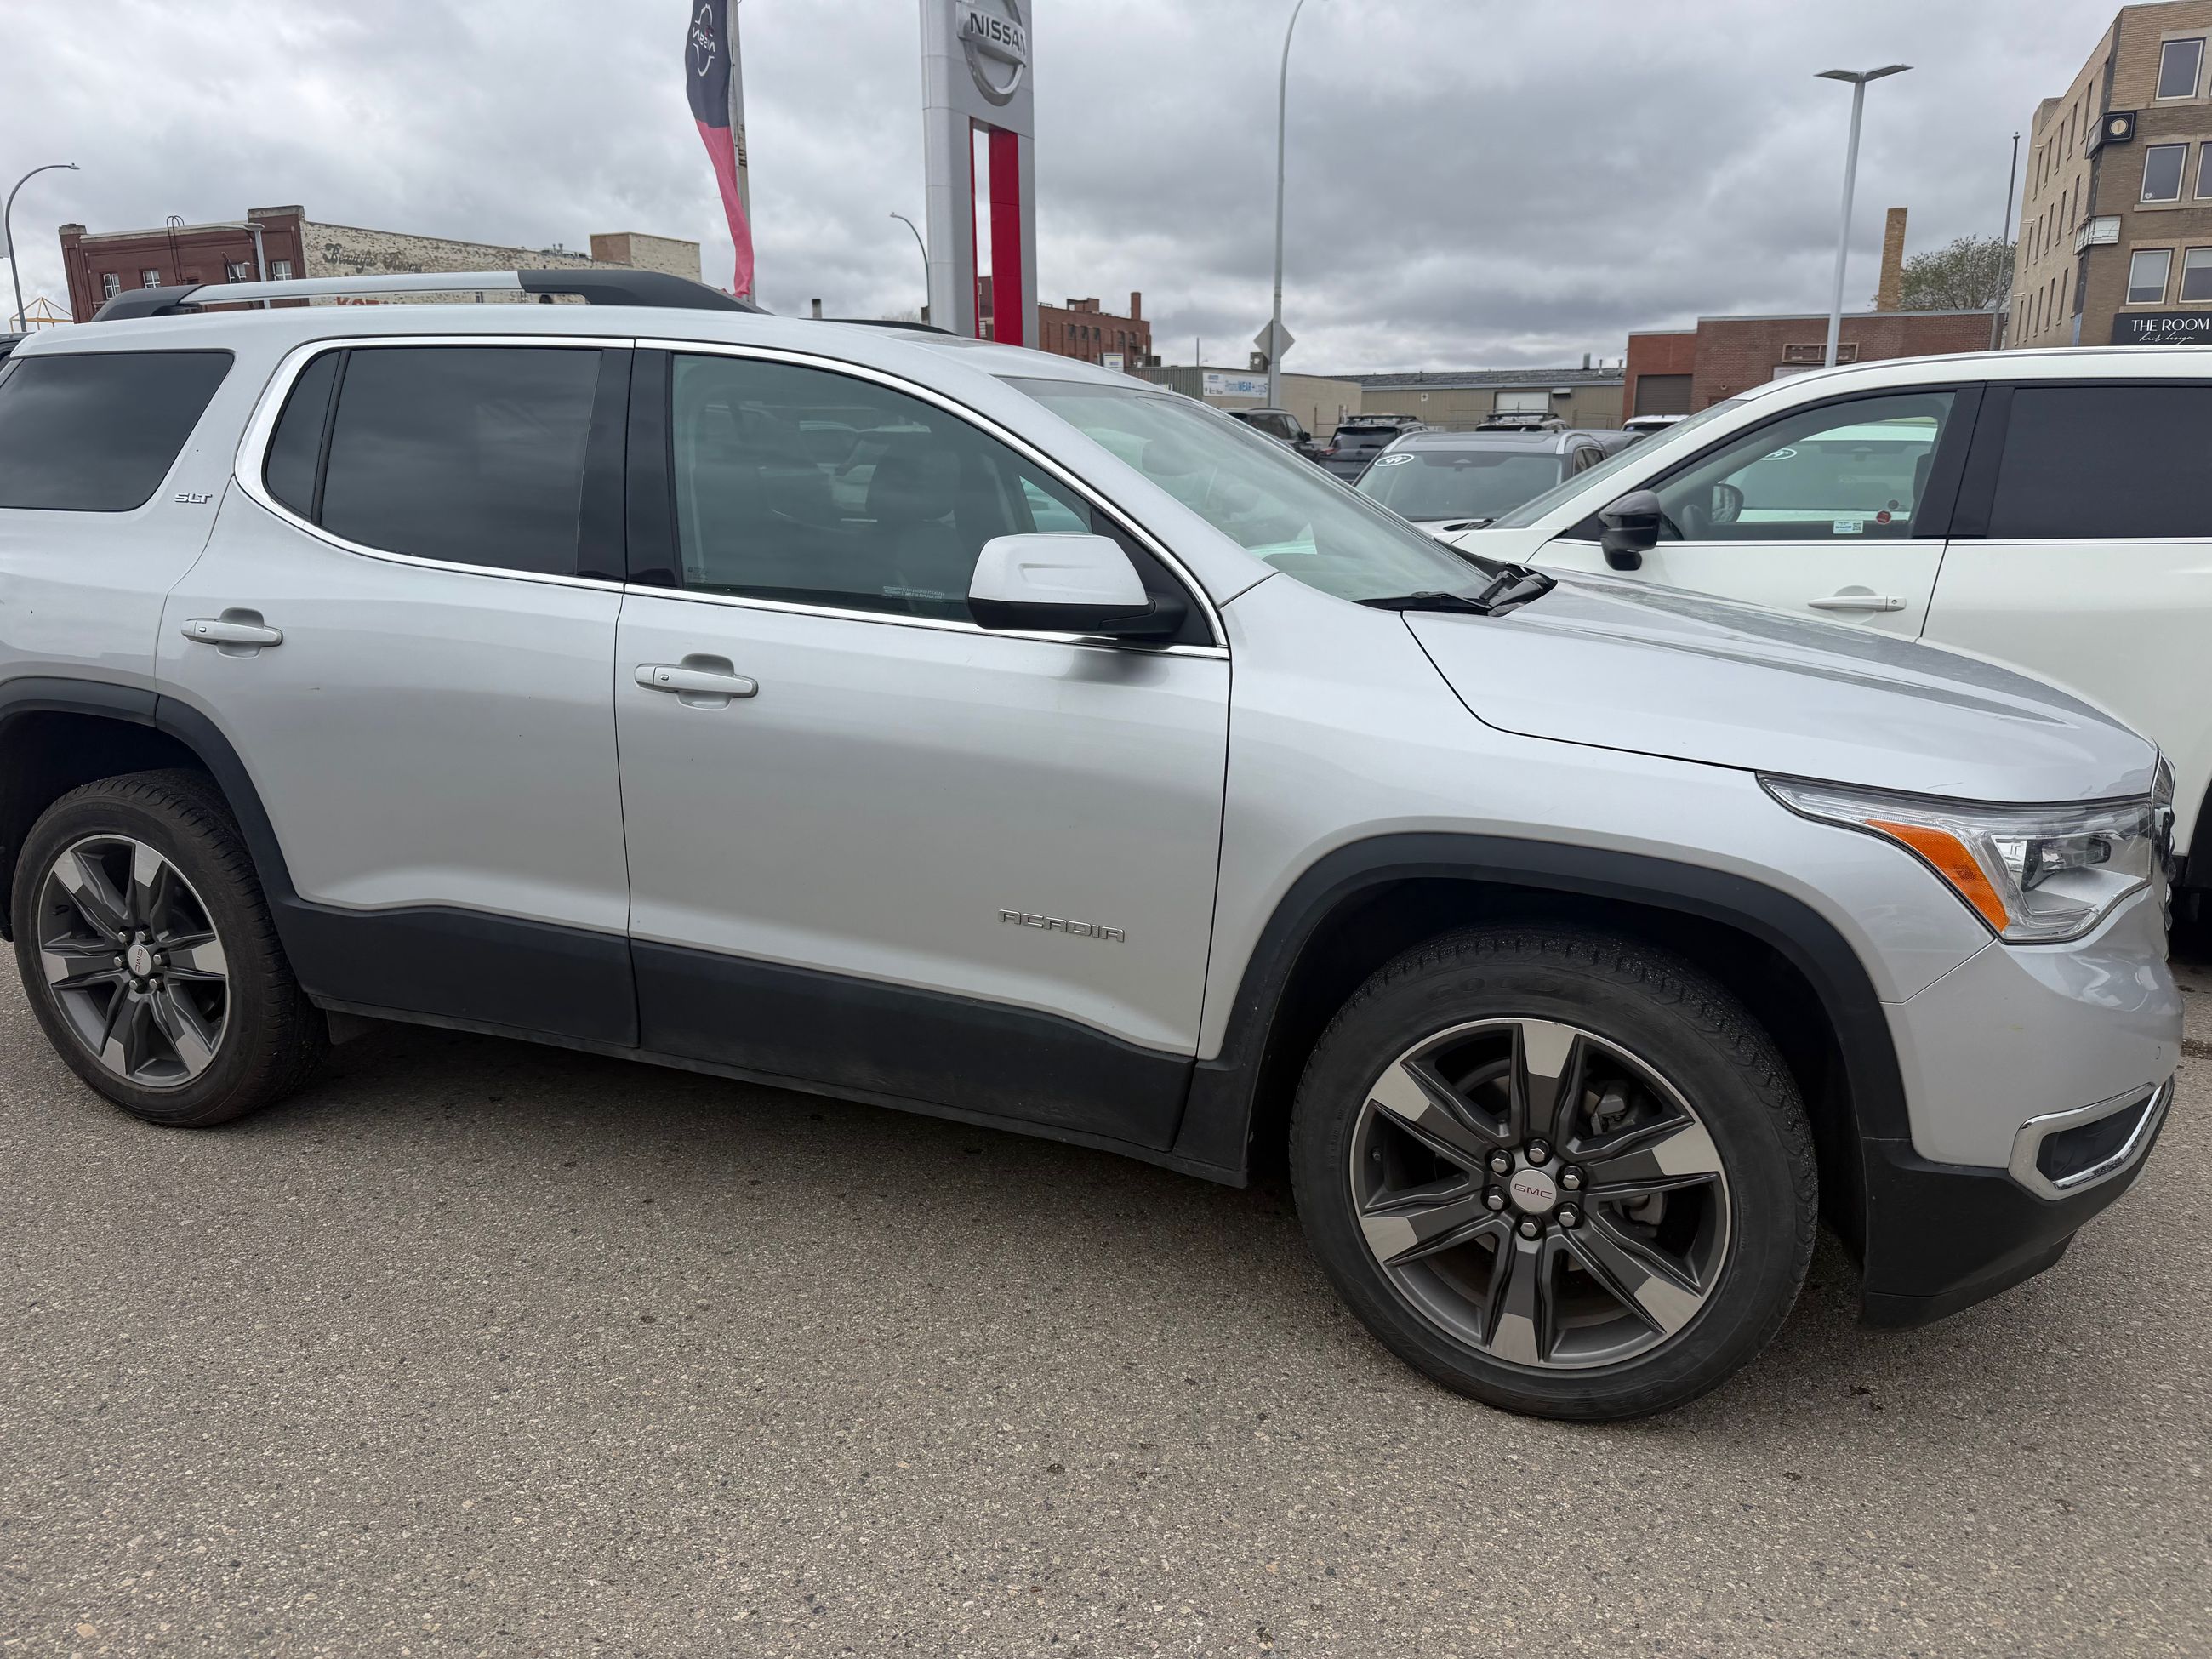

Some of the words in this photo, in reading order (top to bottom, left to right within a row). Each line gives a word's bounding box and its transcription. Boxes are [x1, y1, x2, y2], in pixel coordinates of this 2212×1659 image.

[2131, 319, 2158, 332] THE
[2162, 317, 2210, 331] ROOM
[174, 493, 213, 504] SLT
[998, 909, 1125, 943] ACADIA
[134, 948, 143, 972] GMC
[1514, 1183, 1553, 1200] GMC
